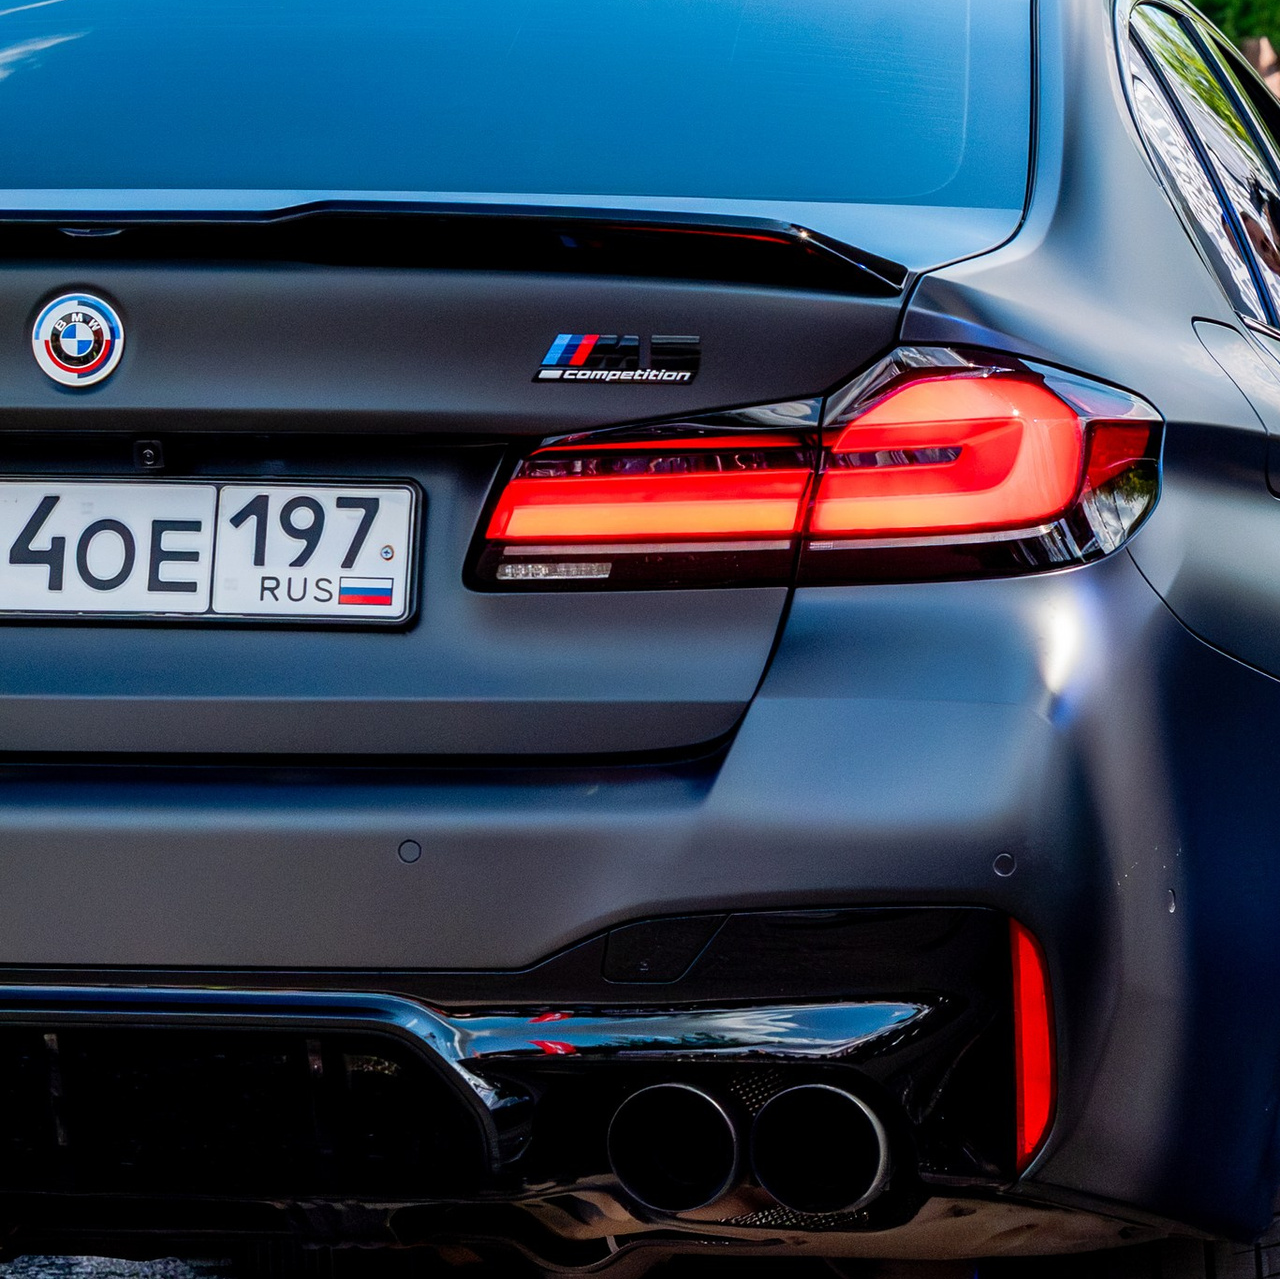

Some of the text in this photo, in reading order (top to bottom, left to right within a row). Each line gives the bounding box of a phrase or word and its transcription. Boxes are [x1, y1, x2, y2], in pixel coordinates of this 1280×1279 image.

[54, 312, 101, 332] BMW
[563, 368, 692, 382] competition
[229, 494, 380, 570] 197
[260, 575, 334, 603] RUS
